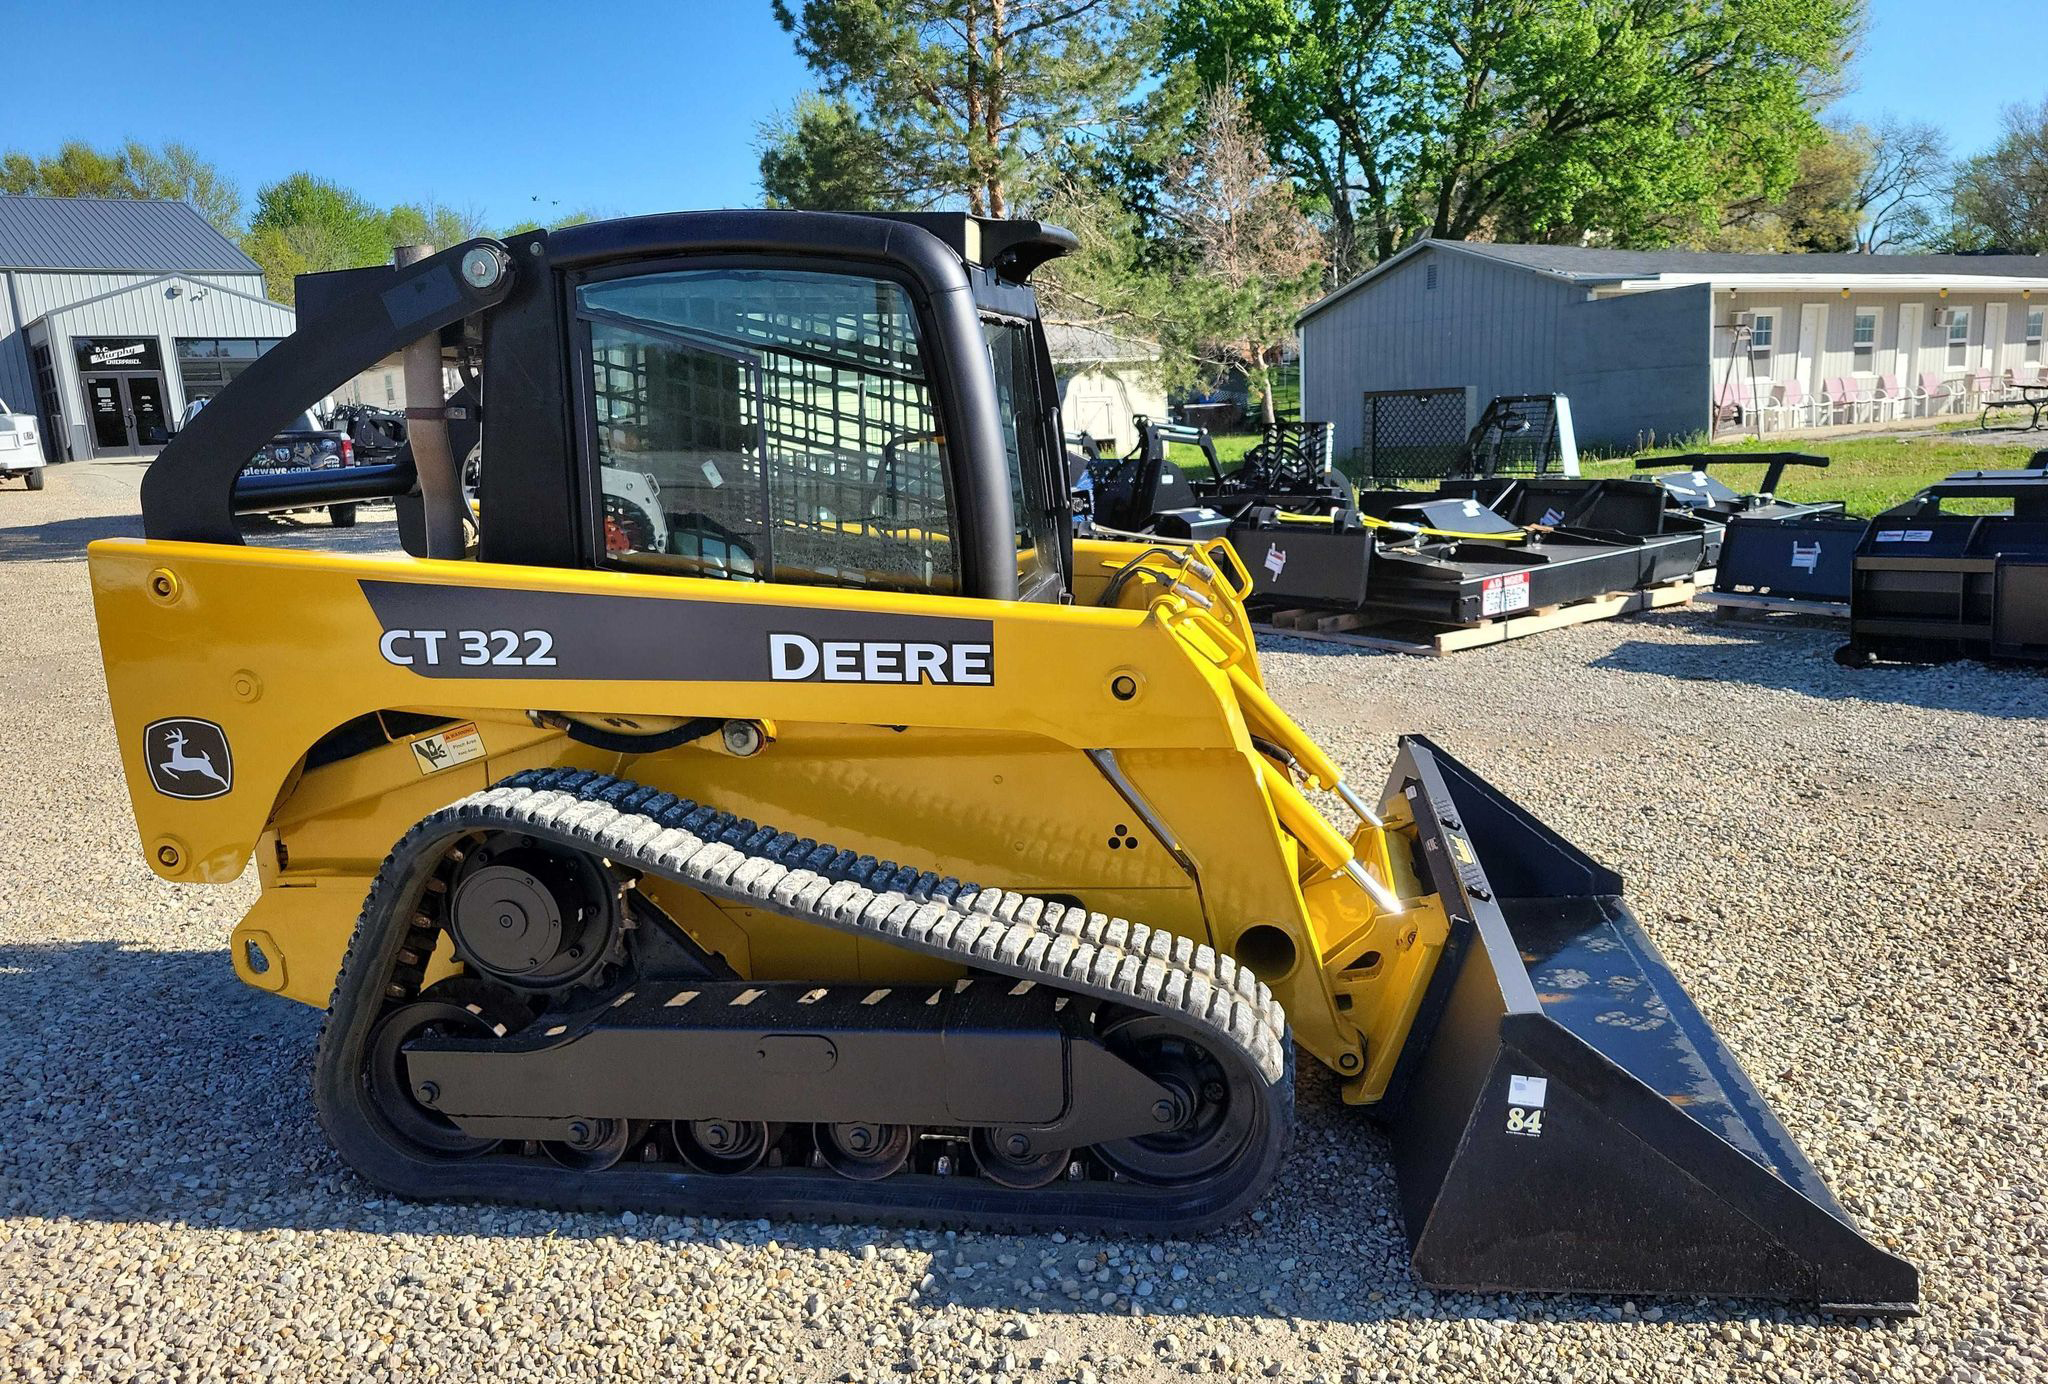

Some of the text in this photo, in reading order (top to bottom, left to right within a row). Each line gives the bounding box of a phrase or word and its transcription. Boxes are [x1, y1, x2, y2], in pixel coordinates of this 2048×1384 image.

[95, 347, 136, 361] Murphy
[1495, 574, 1523, 588] DNGER
[380, 629, 557, 666] CT 322
[769, 633, 992, 684] DEERE
